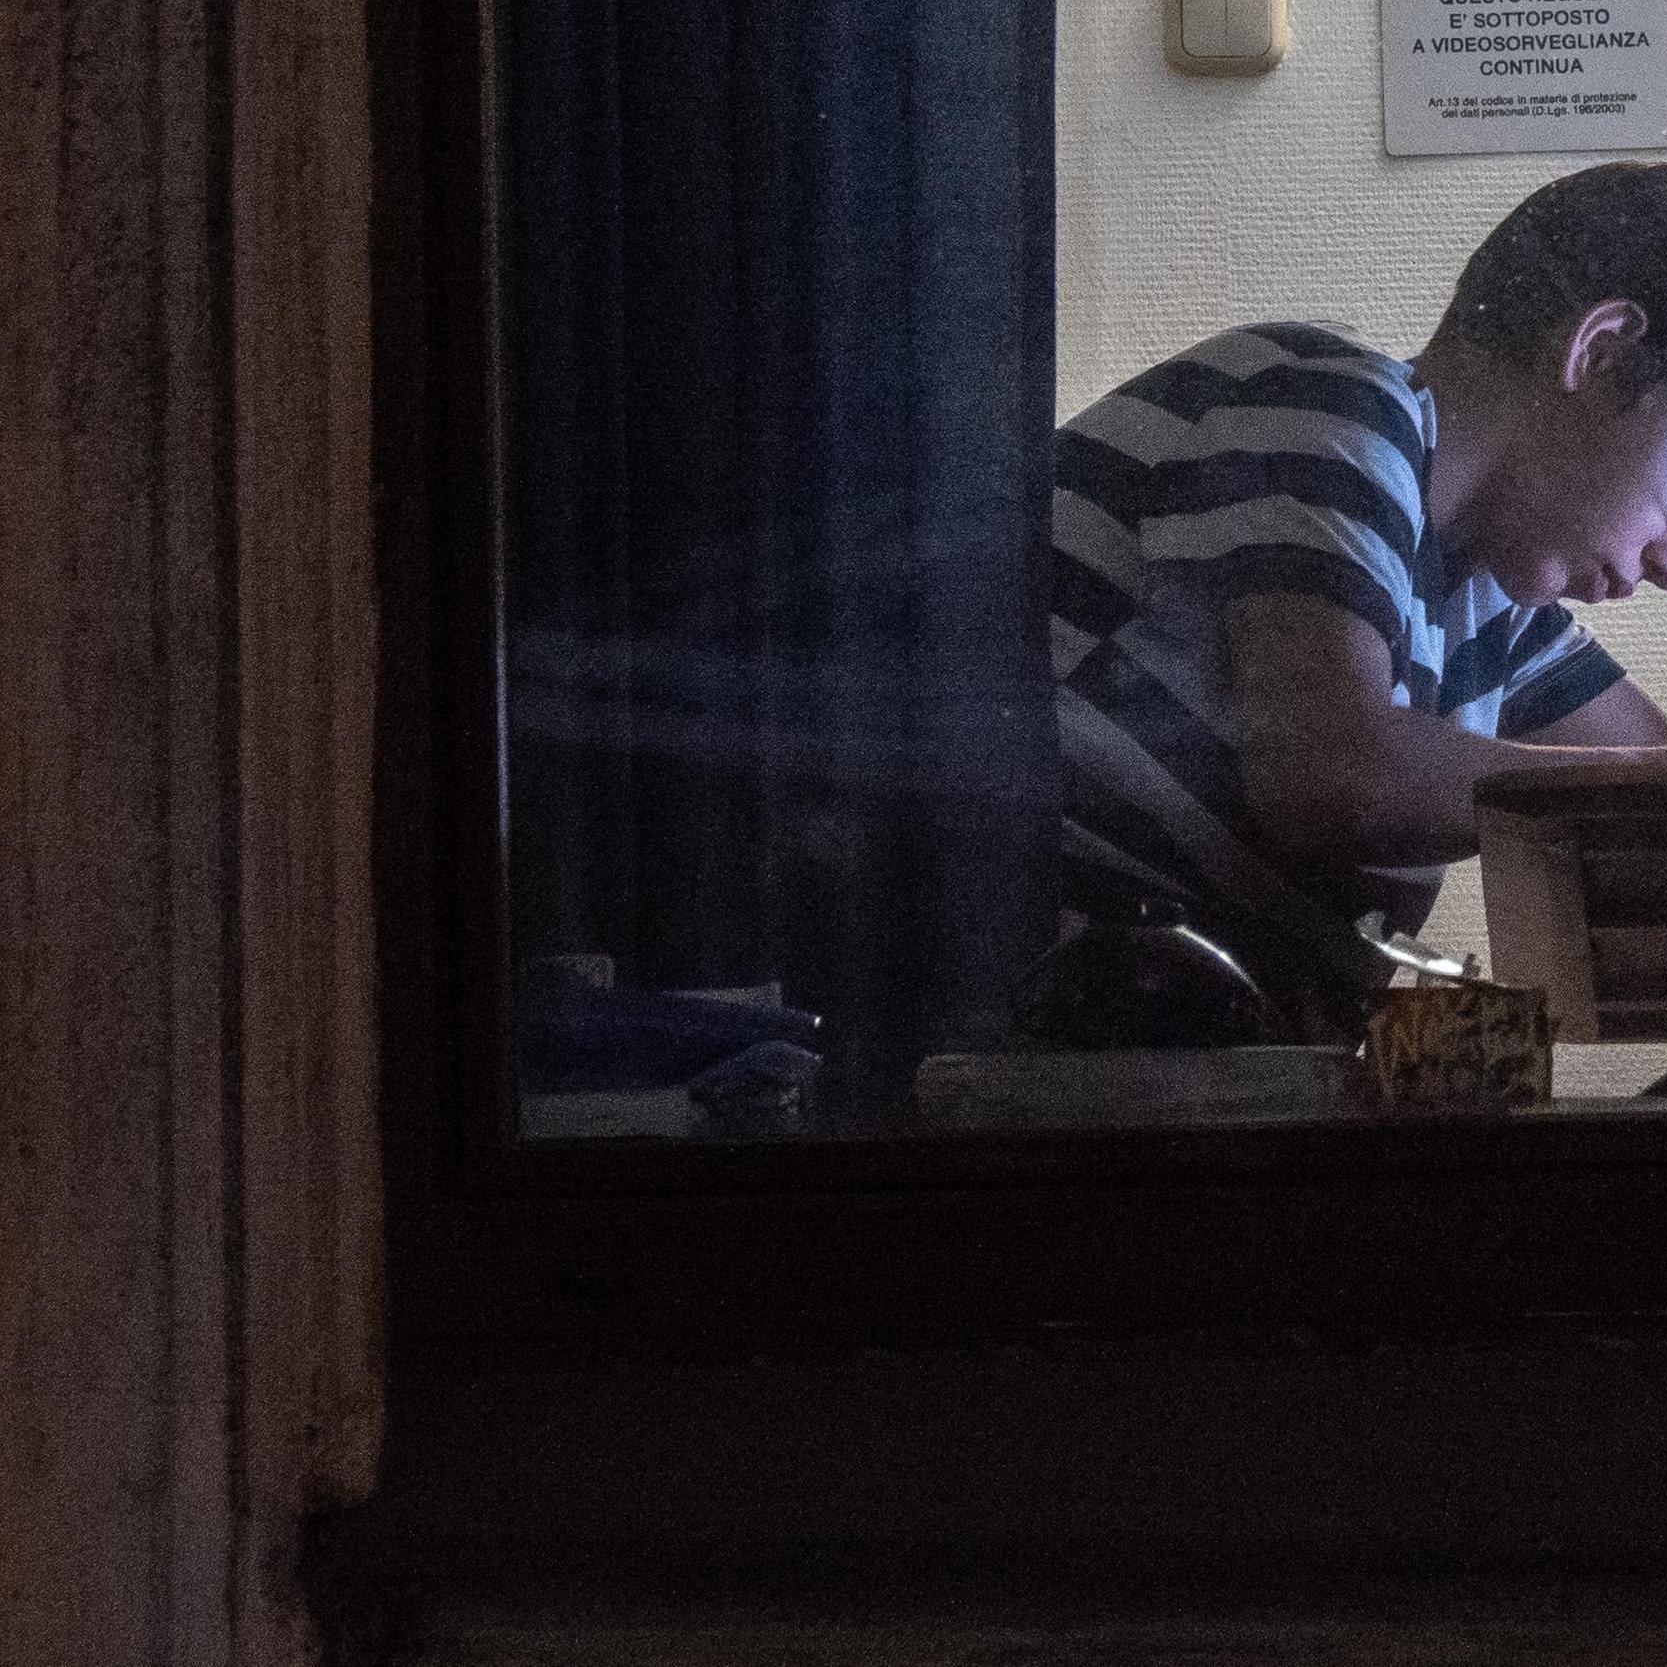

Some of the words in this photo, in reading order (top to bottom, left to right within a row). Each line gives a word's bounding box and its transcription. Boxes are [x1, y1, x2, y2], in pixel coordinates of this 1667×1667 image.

[1450, 14, 1468, 29] E'
[1474, 9, 1611, 29] SOTTOPOSTO
[1412, 38, 1426, 54] A
[1432, 32, 1651, 54] VIDEOSORVEGLIANZA
[1480, 58, 1585, 76] CONTINUA
